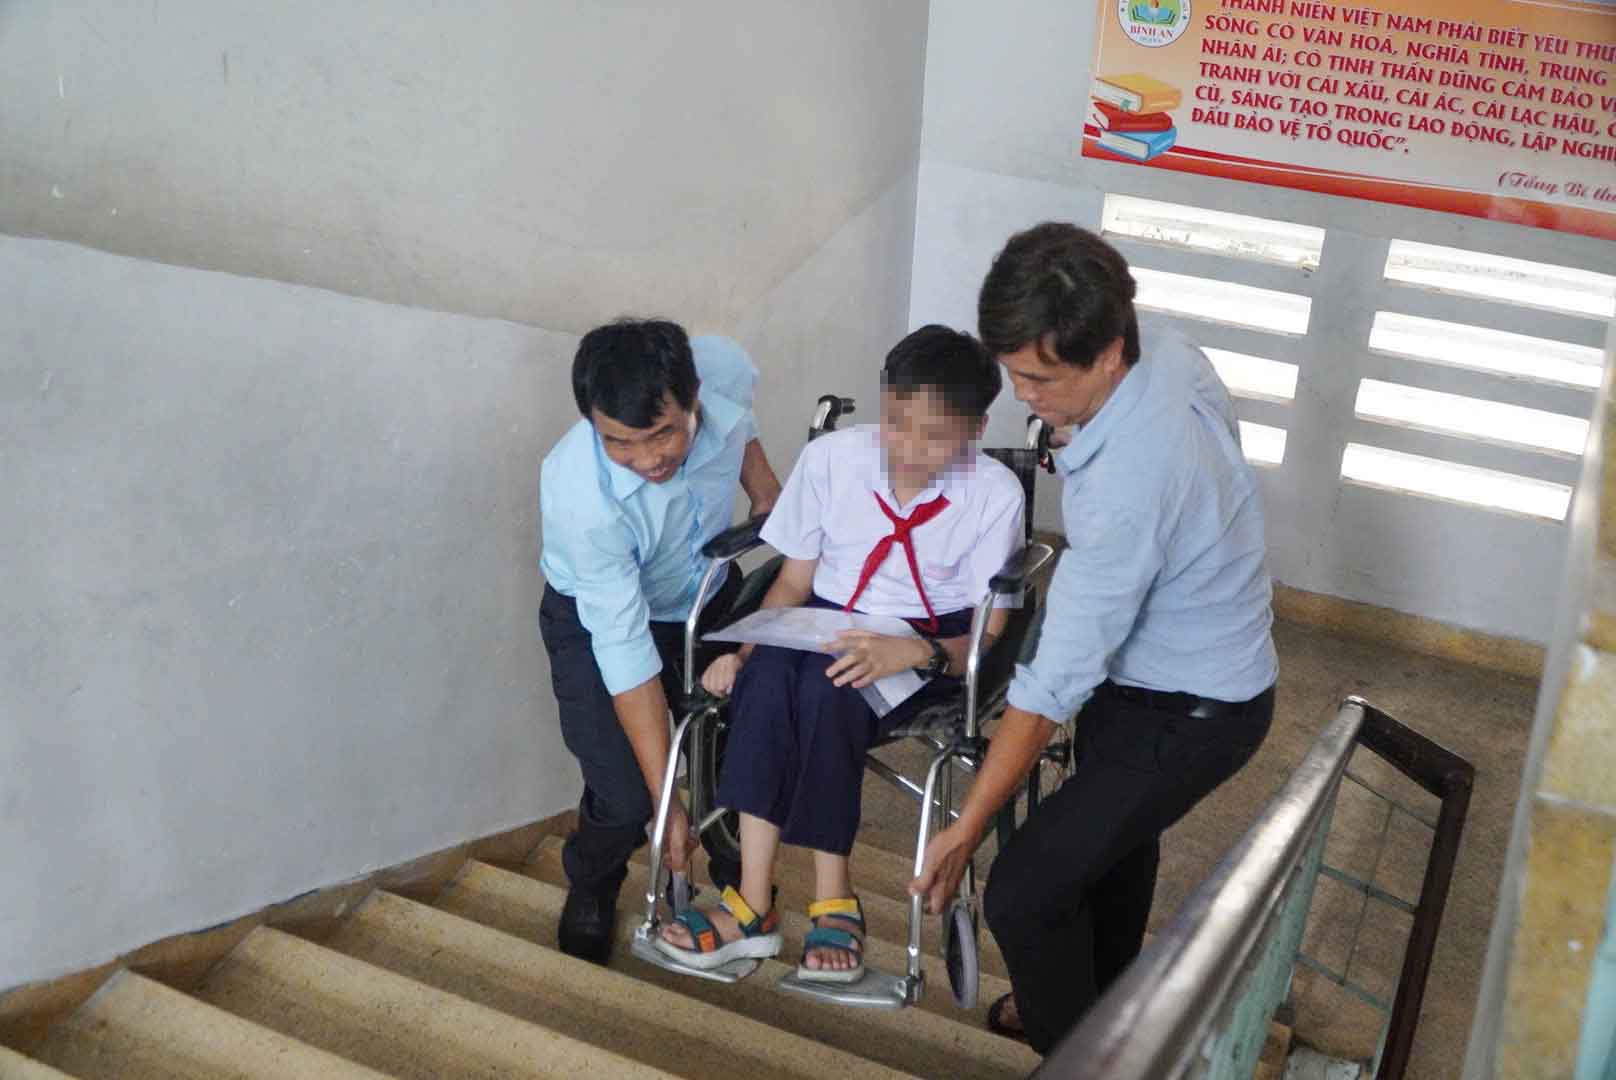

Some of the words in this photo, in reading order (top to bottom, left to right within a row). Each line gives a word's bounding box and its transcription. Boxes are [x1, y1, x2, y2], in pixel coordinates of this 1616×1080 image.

[1205, 12, 1259, 35] SỐNG
[1267, 22, 1295, 40] CÓ
[1303, 26, 1343, 46] VĂN
[1350, 33, 1398, 55] HOÁ,
[1407, 42, 1468, 64] NGHĨA
[1479, 49, 1528, 76] TÌNH,
[1539, 61, 1607, 86] TRUNG
[1290, 1, 1336, 21] NIÊN
[1342, 8, 1384, 28] VIỆT
[1387, 14, 1432, 34] NAM
[1437, 20, 1482, 42] PHẢI
[1488, 26, 1528, 48] BIẾT
[1534, 33, 1568, 55] YÊU
[1200, 62, 1261, 84] TRANH
[1267, 69, 1303, 89] VỚI
[1307, 75, 1338, 95] CÁI
[1344, 79, 1389, 104] XẤU,
[1396, 88, 1429, 108] CÁI
[1433, 91, 1464, 114] ÁC,
[1472, 100, 1505, 119] CÁI
[1511, 106, 1548, 128] LẠC
[1552, 112, 1600, 136] HẬU,
[1201, 38, 1257, 60] NHÂN
[1262, 43, 1287, 64] ÁI;
[1294, 49, 1322, 68] CÓ
[1328, 55, 1374, 75] TINH
[1439, 70, 1496, 93] DŨNG
[1502, 78, 1544, 101] CẢM
[1550, 86, 1593, 109] BẢO
[1601, 95, 1616, 113] V
[1192, 106, 1230, 127] ĐẤU
[1234, 111, 1274, 132] BẢO
[1279, 118, 1302, 140] VỆ
[1305, 120, 1333, 142] TỔ
[1232, 88, 1282, 110] SÁNG
[1289, 98, 1328, 119] TẠO
[1334, 104, 1402, 128] TRONG
[1407, 114, 1446, 134] LAO
[1451, 121, 1515, 147] ĐỘNG,
[1522, 131, 1557, 153] LẬP
[1562, 138, 1616, 162] NGHI
